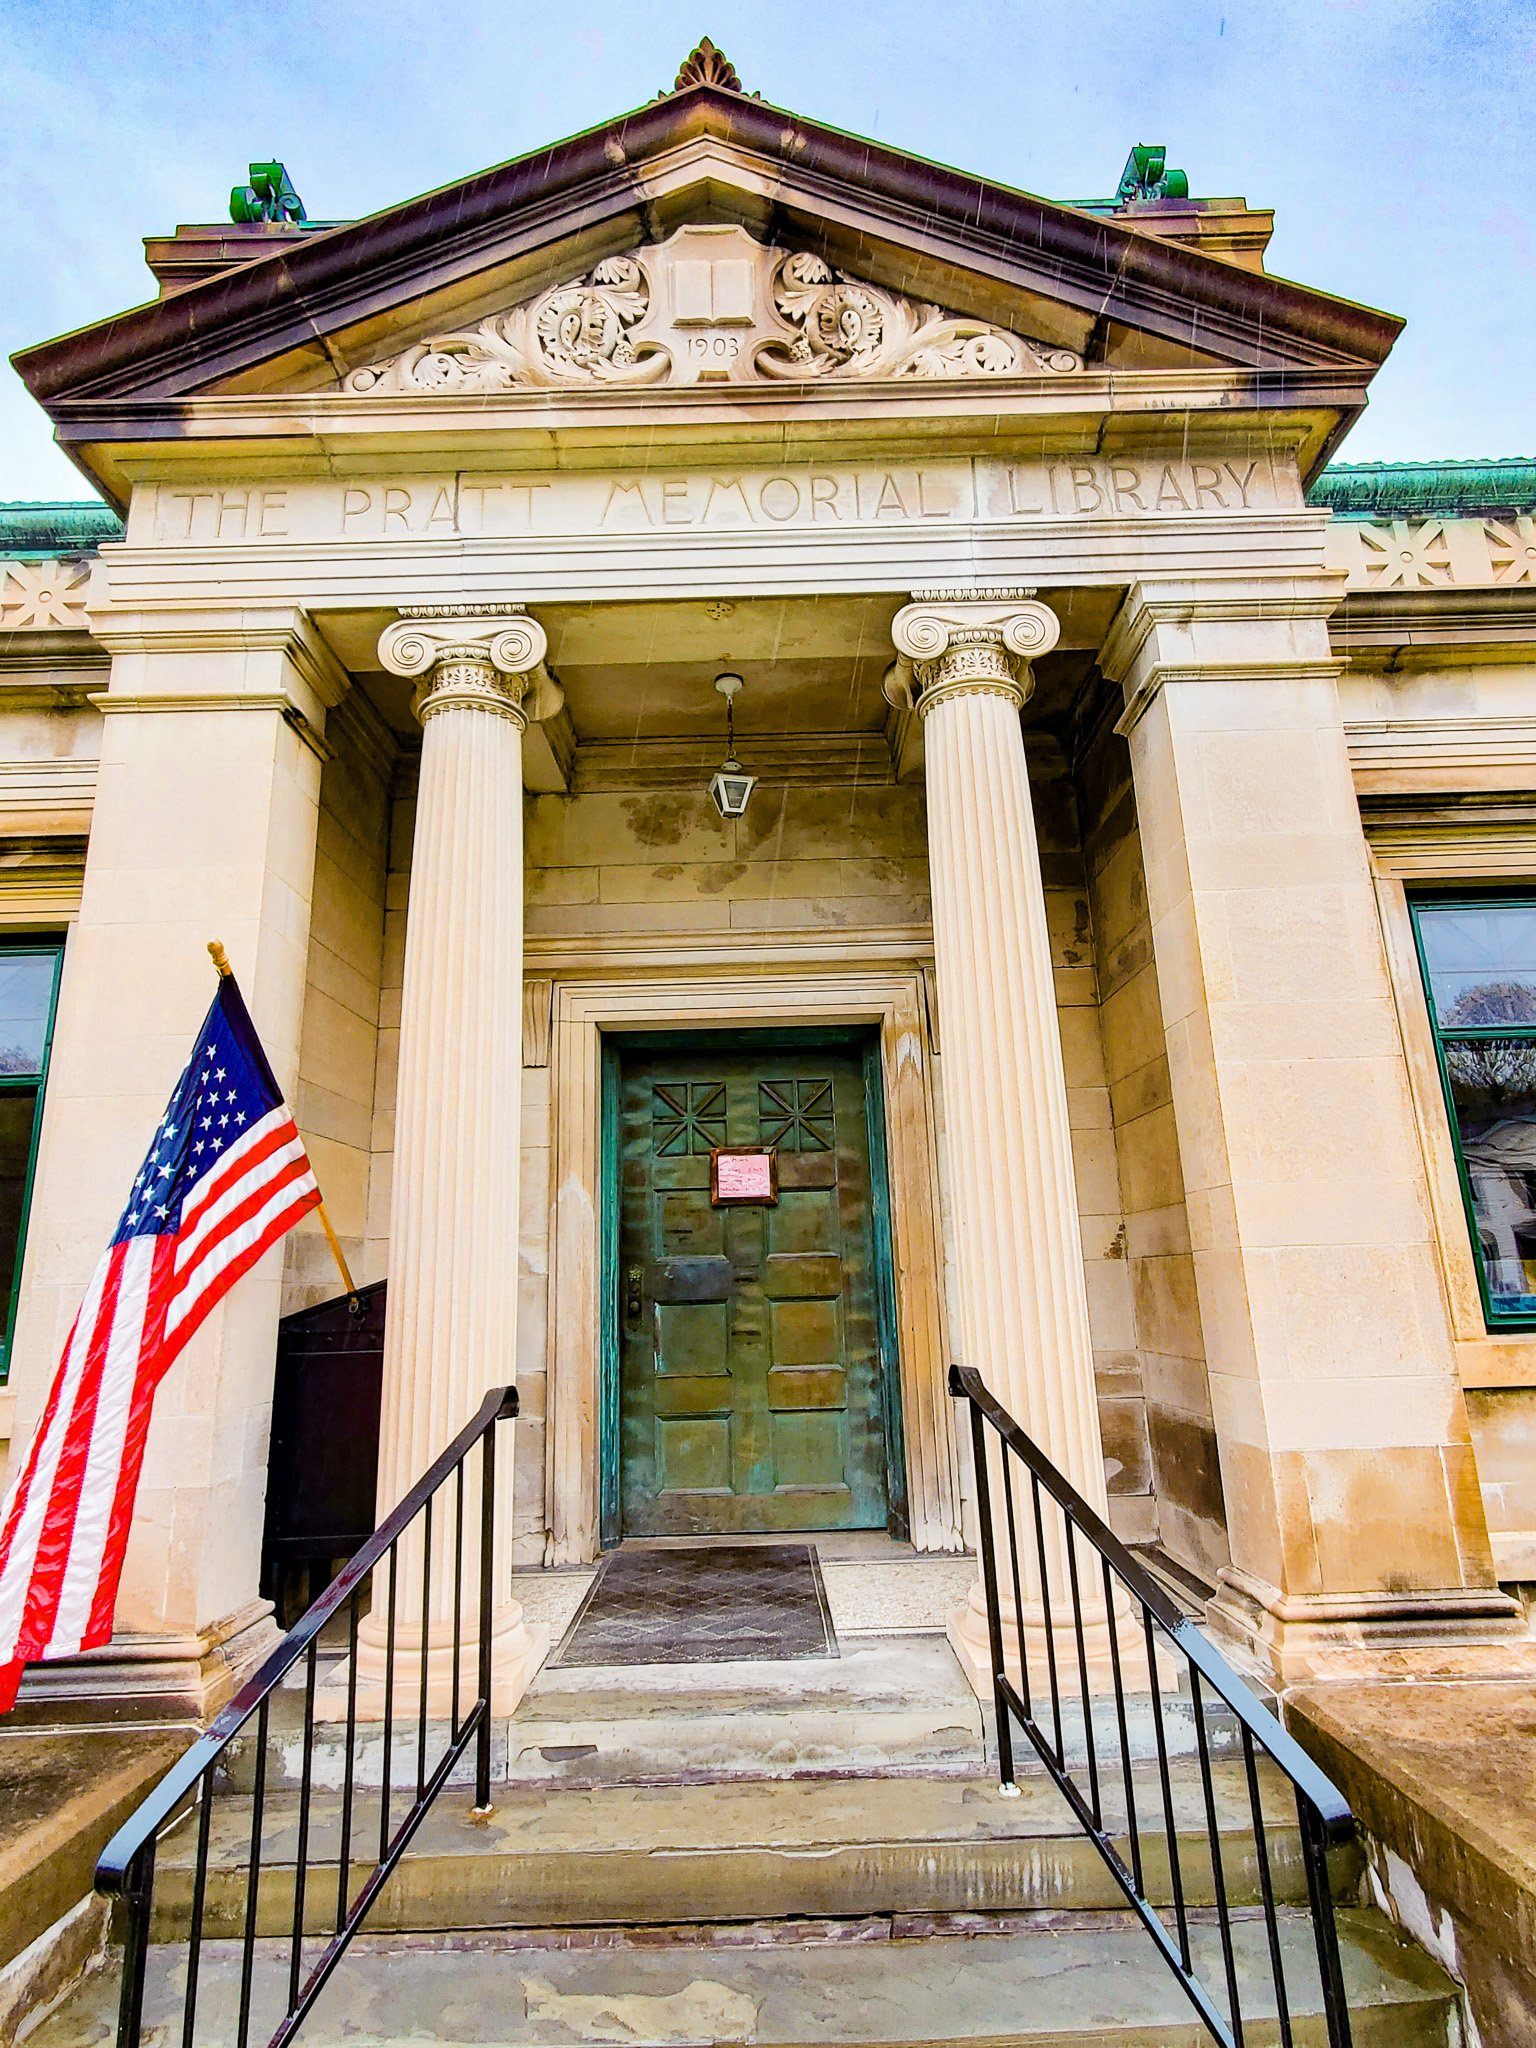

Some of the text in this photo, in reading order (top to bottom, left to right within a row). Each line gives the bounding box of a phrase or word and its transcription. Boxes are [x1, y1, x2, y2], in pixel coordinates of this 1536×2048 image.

[687, 337, 739, 357] 1903
[172, 461, 1257, 539] THE PRATT MEMORIAL LIBRARY
